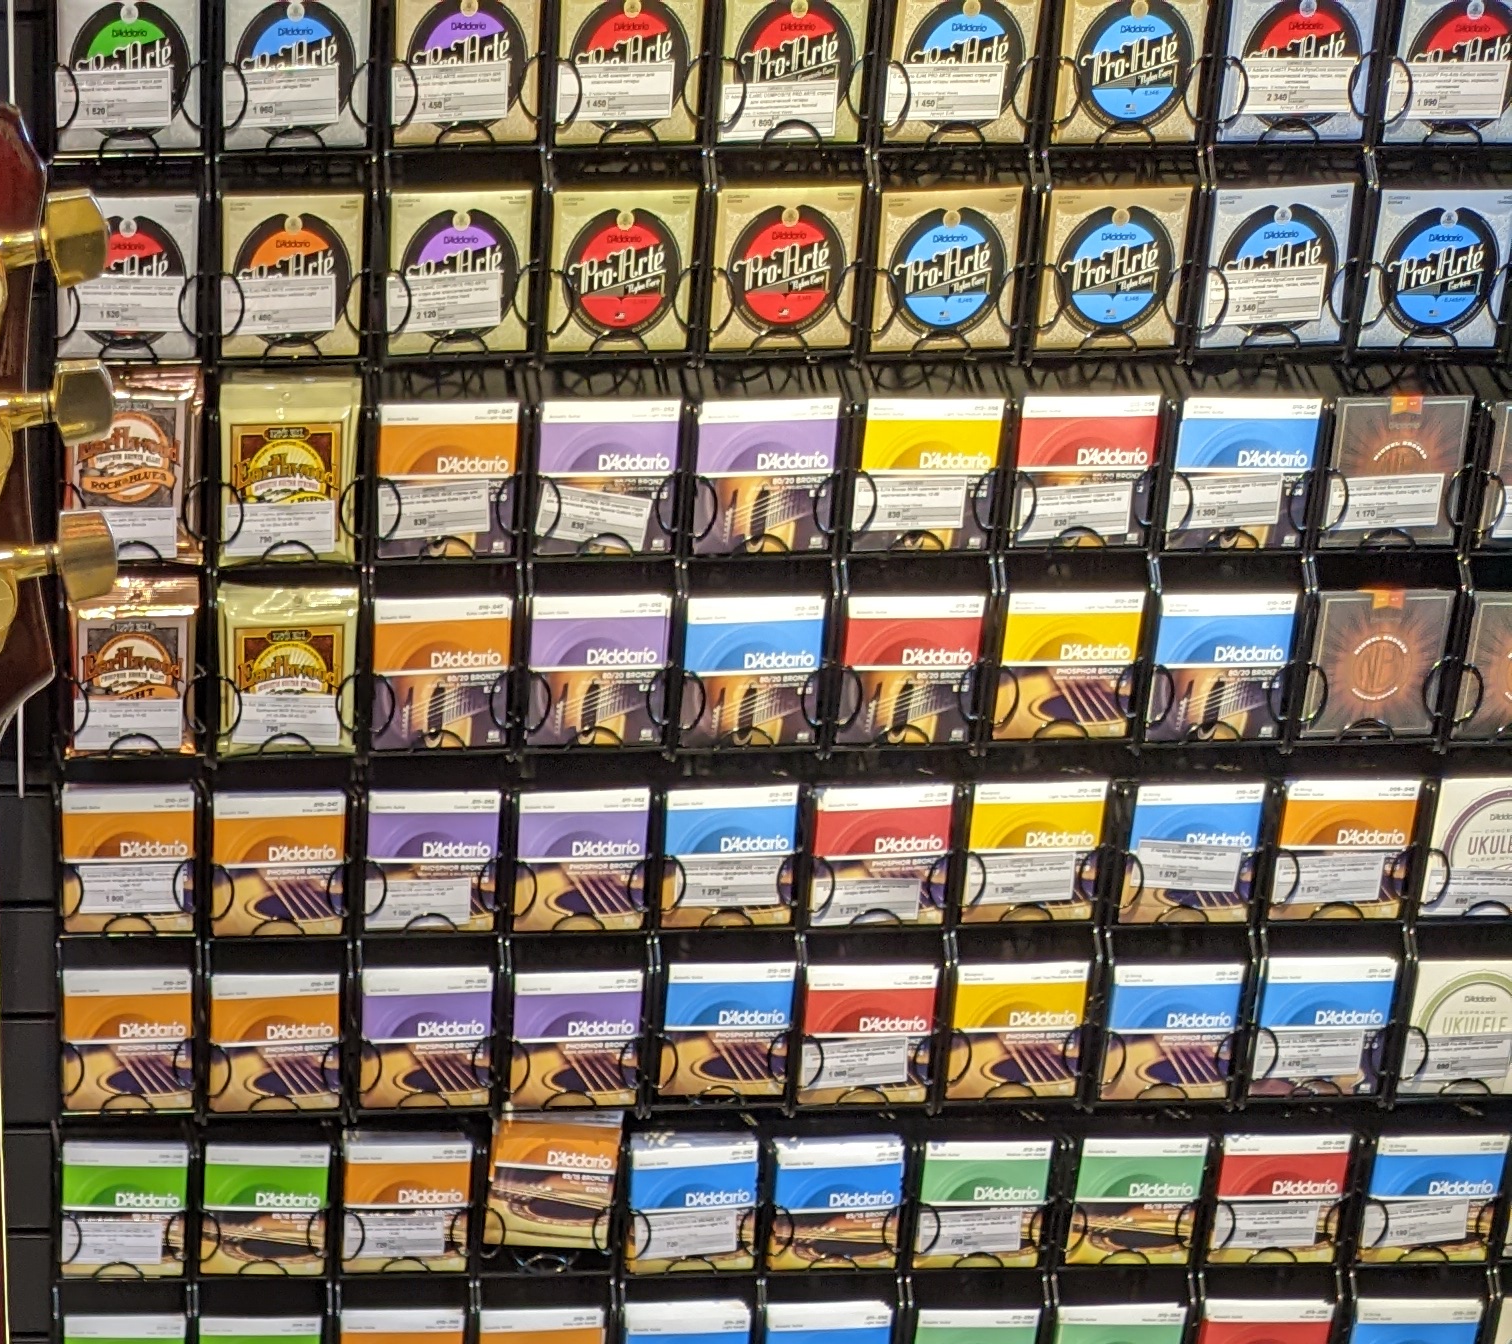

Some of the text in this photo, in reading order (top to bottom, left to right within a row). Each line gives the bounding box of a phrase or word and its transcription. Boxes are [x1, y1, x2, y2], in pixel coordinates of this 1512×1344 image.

[437, 456, 509, 473] D'Addario
[598, 452, 670, 471] D'Addario
[757, 451, 829, 470] D'Addario
[920, 451, 991, 469] D'Addario
[1077, 446, 1148, 465] D'Addario
[1237, 448, 1308, 468] D'Addario
[430, 649, 502, 668] D'Addario
[587, 646, 658, 665] D'Addario
[744, 650, 815, 670] D'Addario
[902, 647, 972, 665] D'Addario
[1059, 642, 1131, 661] D'Addario
[1214, 643, 1284, 662] D'Addario
[720, 834, 790, 852] D'Addario
[874, 834, 944, 853] D'Addario
[1025, 829, 1095, 848] D'Addario
[1336, 828, 1405, 845] D'Addario
[1468, 834, 1512, 856] UKULE
[119, 840, 188, 859] D'Addario
[268, 843, 337, 862] D'Addario
[422, 840, 491, 859] D'Addario
[572, 838, 641, 857] D'Addario
[718, 1008, 786, 1026] D'Addario
[859, 1015, 927, 1033] D'Addario
[1008, 1008, 1077, 1027] D'Addario
[1166, 1010, 1232, 1029] D'Addario
[1314, 1008, 1383, 1026] D'Addario
[118, 1021, 187, 1039] D'Addario
[266, 1021, 334, 1040] D'Addario
[417, 1019, 485, 1037] D'Addario
[567, 1017, 636, 1037] D'Addario
[547, 1149, 613, 1169] D'Addario
[397, 1187, 464, 1204] D'Addario
[973, 1185, 1040, 1202] D'Addario
[1128, 1181, 1194, 1197] D'Addario
[1271, 1179, 1338, 1196] D'Addario
[1428, 1178, 1495, 1196] D'Addario
[114, 1189, 181, 1207] D'Addario
[254, 1189, 321, 1207] D'Addario
[685, 1188, 751, 1207] D'Addario
[829, 1188, 895, 1208] D'Addario
